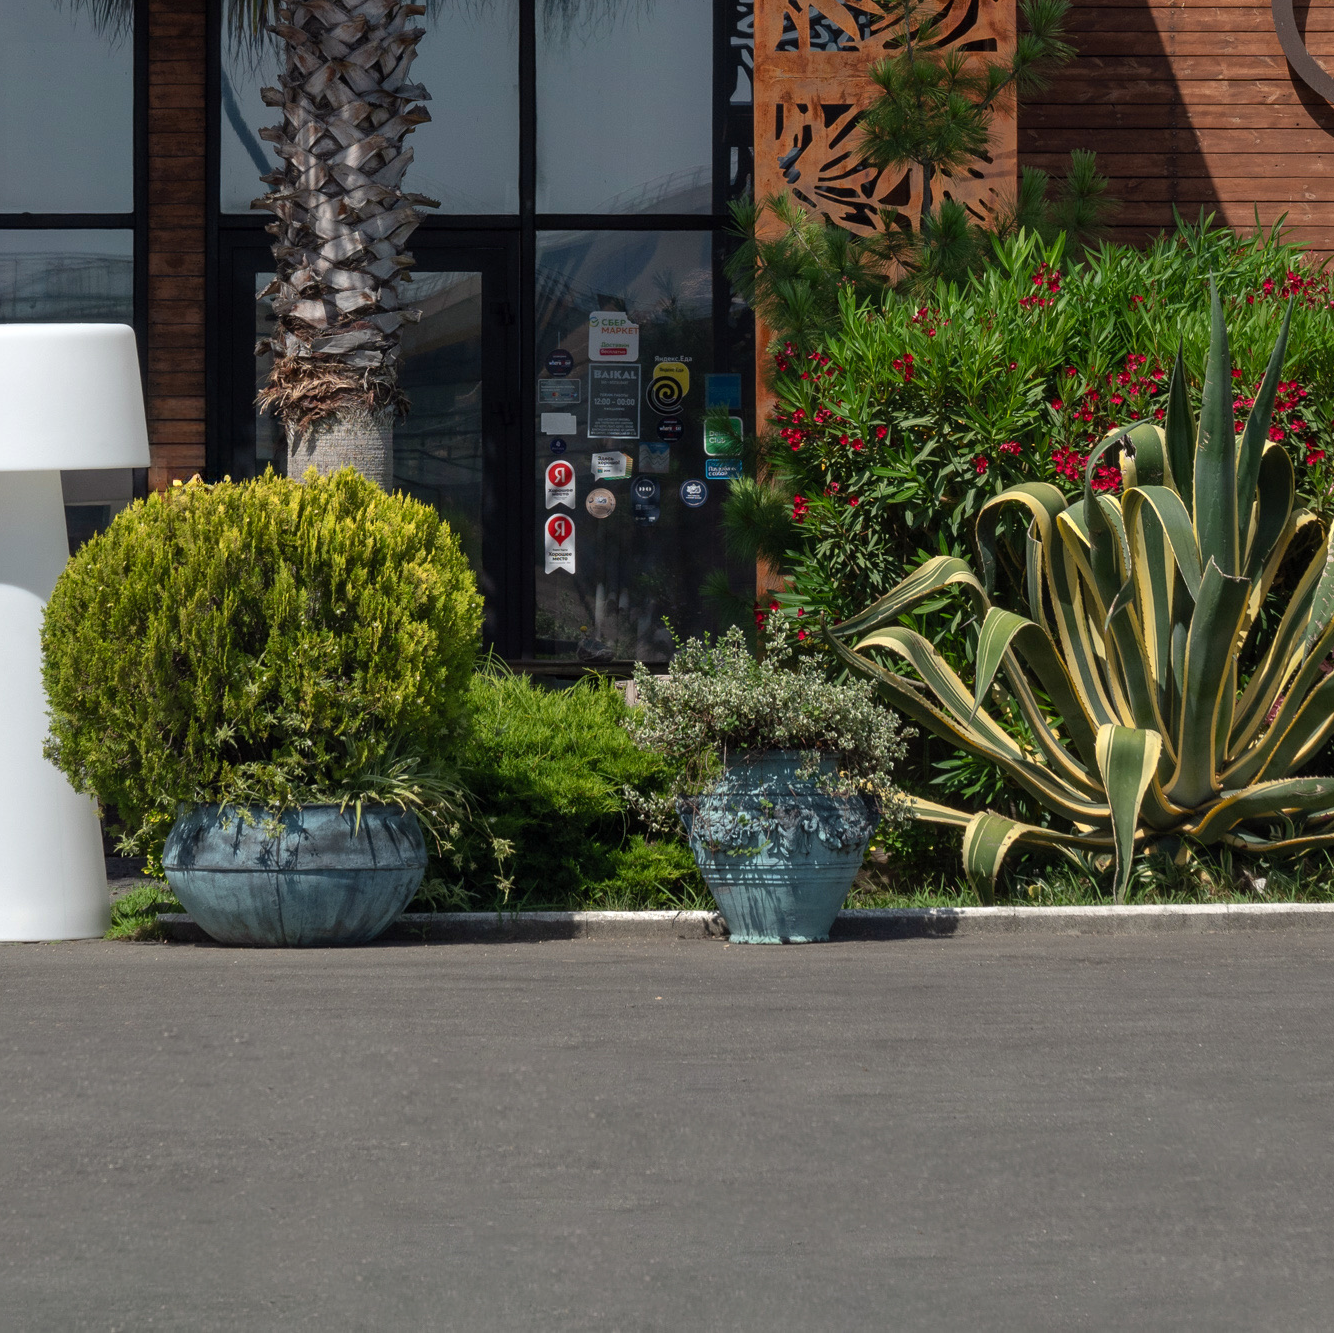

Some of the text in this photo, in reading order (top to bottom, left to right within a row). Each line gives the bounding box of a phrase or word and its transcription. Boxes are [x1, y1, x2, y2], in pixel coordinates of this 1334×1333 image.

[601, 318, 626, 327] СБЕР
[601, 326, 639, 335] МАРКЕТ
[654, 355, 693, 363] Яндекс.Еда
[593, 369, 637, 379] BAIKAL
[594, 397, 611, 405] 12:00
[616, 398, 635, 406] 00:00
[554, 467, 565, 483] Я
[554, 520, 565, 537] Я
